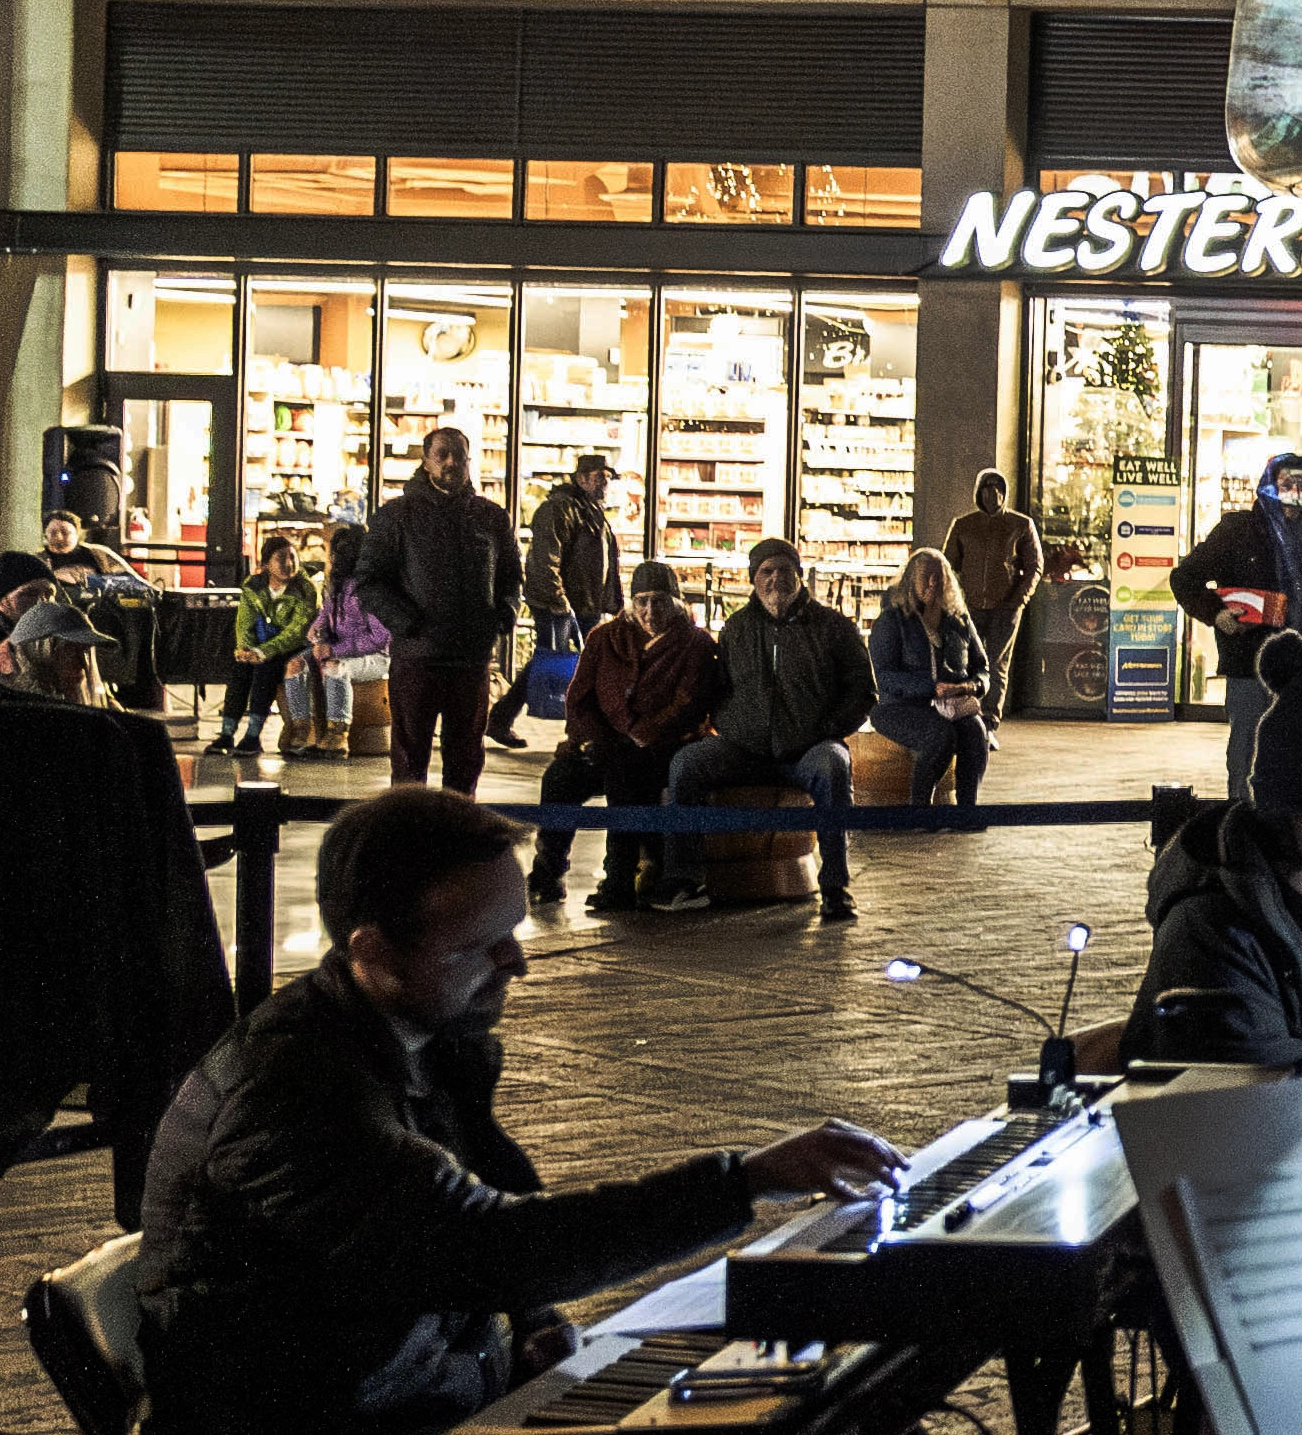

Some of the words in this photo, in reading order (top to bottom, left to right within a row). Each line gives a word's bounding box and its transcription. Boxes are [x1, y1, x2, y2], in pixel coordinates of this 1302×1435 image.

[1119, 460, 1141, 471] EAT
[1145, 460, 1177, 473] WELL
[1116, 472, 1143, 483] LIVE
[1147, 473, 1179, 484] WELL
